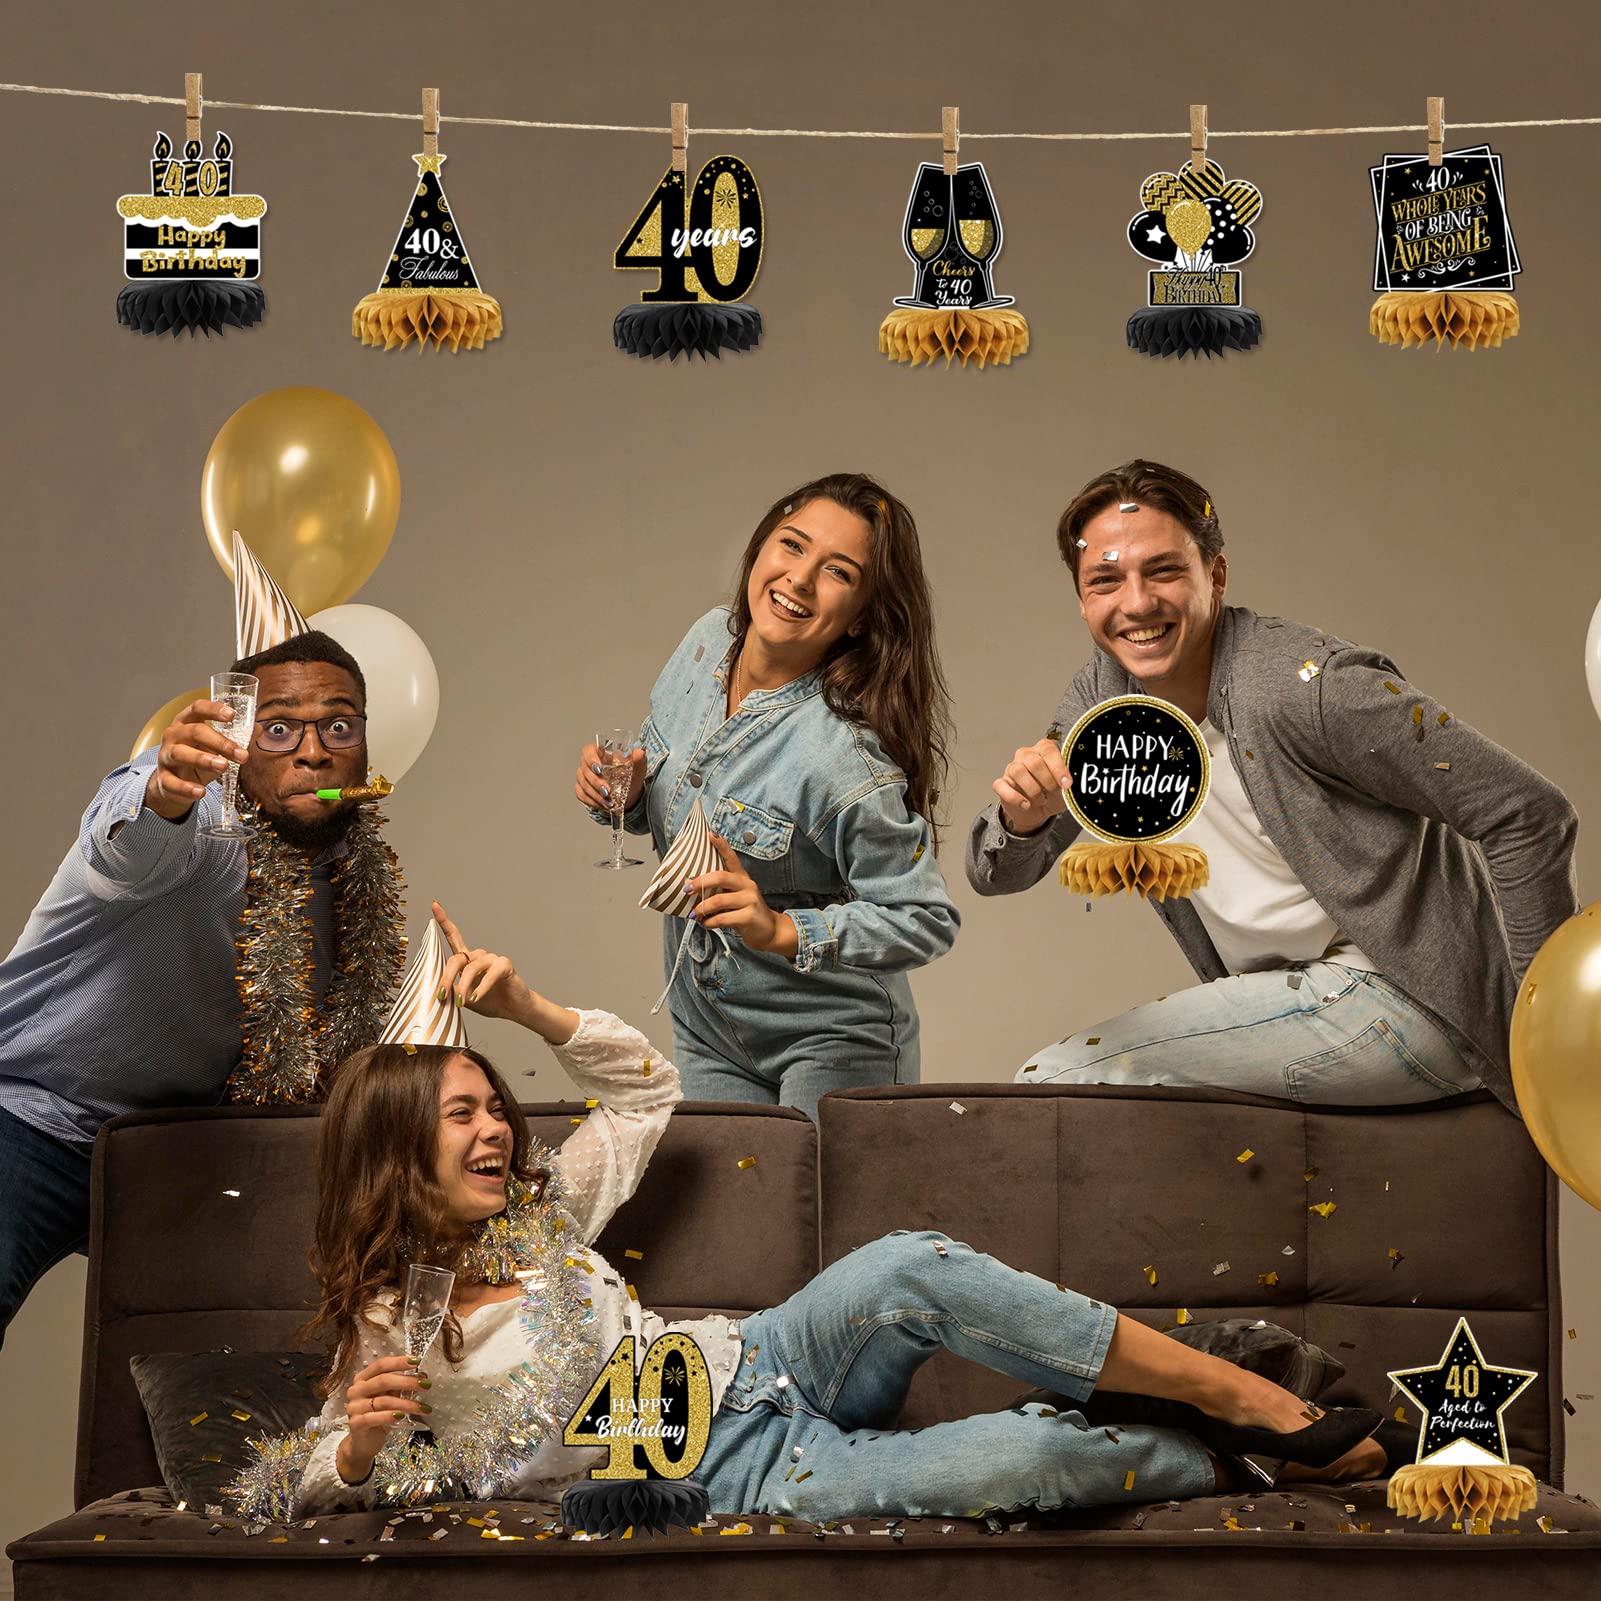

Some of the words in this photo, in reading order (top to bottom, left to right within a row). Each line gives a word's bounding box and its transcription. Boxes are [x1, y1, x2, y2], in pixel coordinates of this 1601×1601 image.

[164, 160, 220, 196] 40
[1391, 194, 1440, 222] WHOLE
[1443, 183, 1487, 211] YEARS
[157, 225, 226, 250] Happy
[613, 154, 765, 304] 40
[1404, 219, 1424, 241] OF
[1426, 208, 1473, 236] BEING
[670, 226, 758, 259] years
[1391, 215, 1492, 272] AWESOME
[139, 249, 247, 278] Birthday
[399, 255, 460, 280] Fabulous
[932, 259, 976, 277] Cheers
[934, 290, 973, 306] Years
[935, 278, 949, 289] to
[950, 279, 973, 295] 40
[1163, 282, 1222, 303] BIRTHDAY
[1096, 733, 1174, 761] HAPPY
[1080, 762, 1190, 817] Birthday
[1445, 1364, 1480, 1398] 40
[563, 1332, 713, 1480] 40
[611, 1398, 673, 1413] HAPPY
[1438, 1398, 1472, 1418] Aged
[1474, 1400, 1487, 1412] to
[595, 1415, 686, 1446] Birthday
[1429, 1415, 1496, 1433] Perfection
